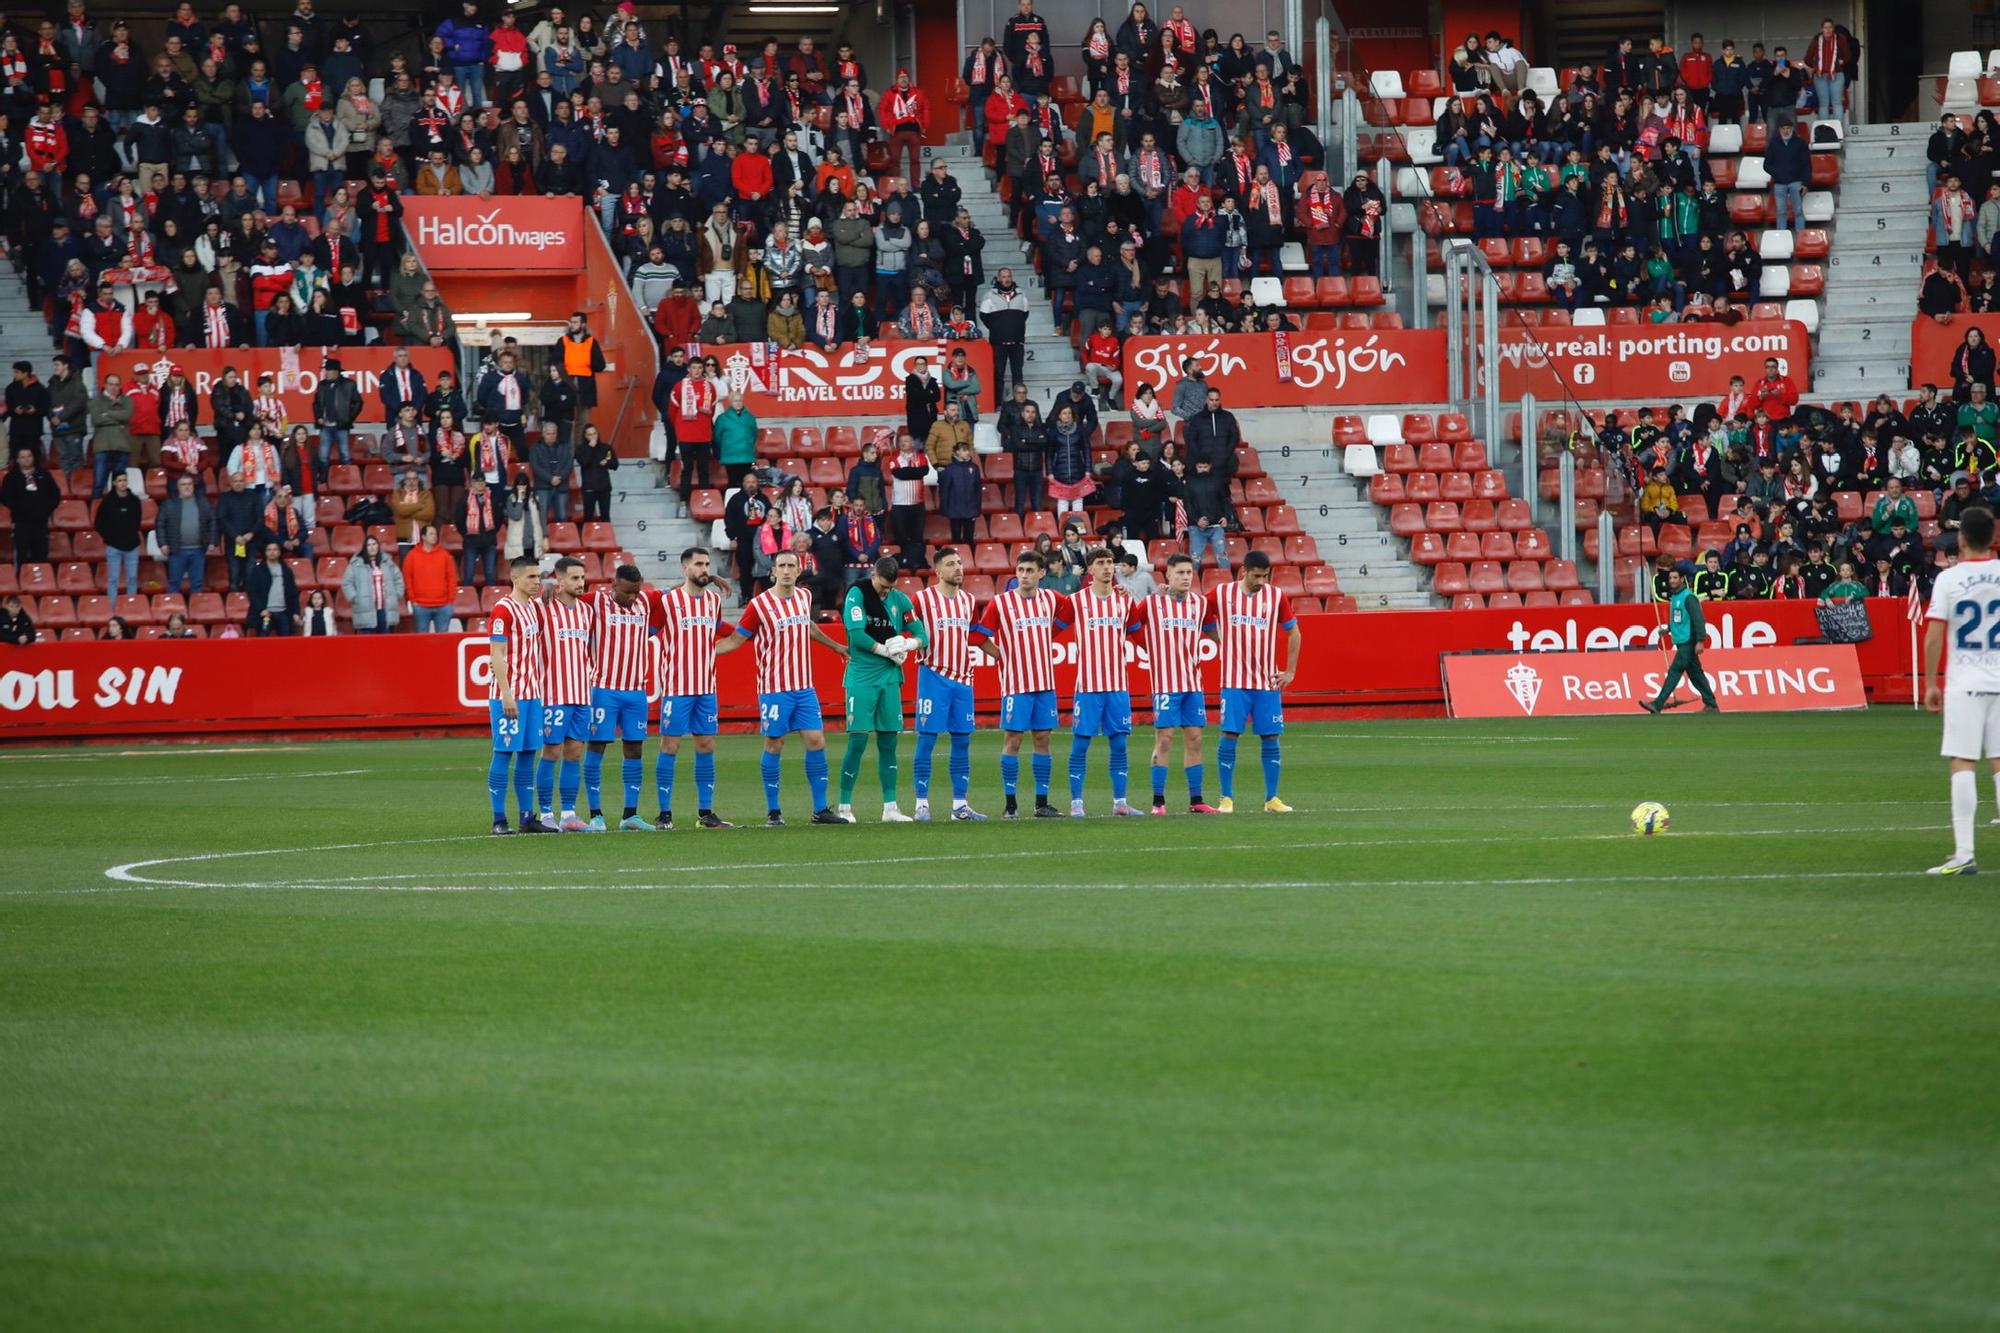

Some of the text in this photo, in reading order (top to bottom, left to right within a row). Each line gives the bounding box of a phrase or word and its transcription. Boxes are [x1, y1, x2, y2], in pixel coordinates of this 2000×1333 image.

[1890, 125, 1900, 135] 8
[1886, 147, 1895, 158] 7
[1881, 182, 1890, 193] 6
[1877, 218, 1886, 230] 5
[1872, 255, 1881, 266] 4
[1862, 329, 1871, 340] 2
[1026, 350, 1035, 361] 2
[1859, 366, 1865, 377] 1
[778, 385, 837, 402] TRAVEL
[842, 385, 885, 401] CLUB
[1281, 446, 1290, 458] 8
[1300, 476, 1308, 487] 7
[619, 492, 627, 503] 7
[1319, 504, 1328, 516] 6
[637, 520, 647, 532] 6
[1339, 534, 1347, 546] 5
[658, 550, 667, 562] 5
[1359, 564, 1368, 577] 4
[1380, 595, 1388, 607] 3
[94, 666, 183, 708] SIN
[1561, 672, 1632, 701] Real
[848, 697, 854, 712] 1
[918, 698, 933, 715] 18
[1006, 697, 1014, 713] 8
[1155, 694, 1170, 710] 12
[663, 701, 673, 717] 4
[761, 703, 779, 720] 24
[544, 709, 564, 726] 22
[499, 718, 519, 735] 23
